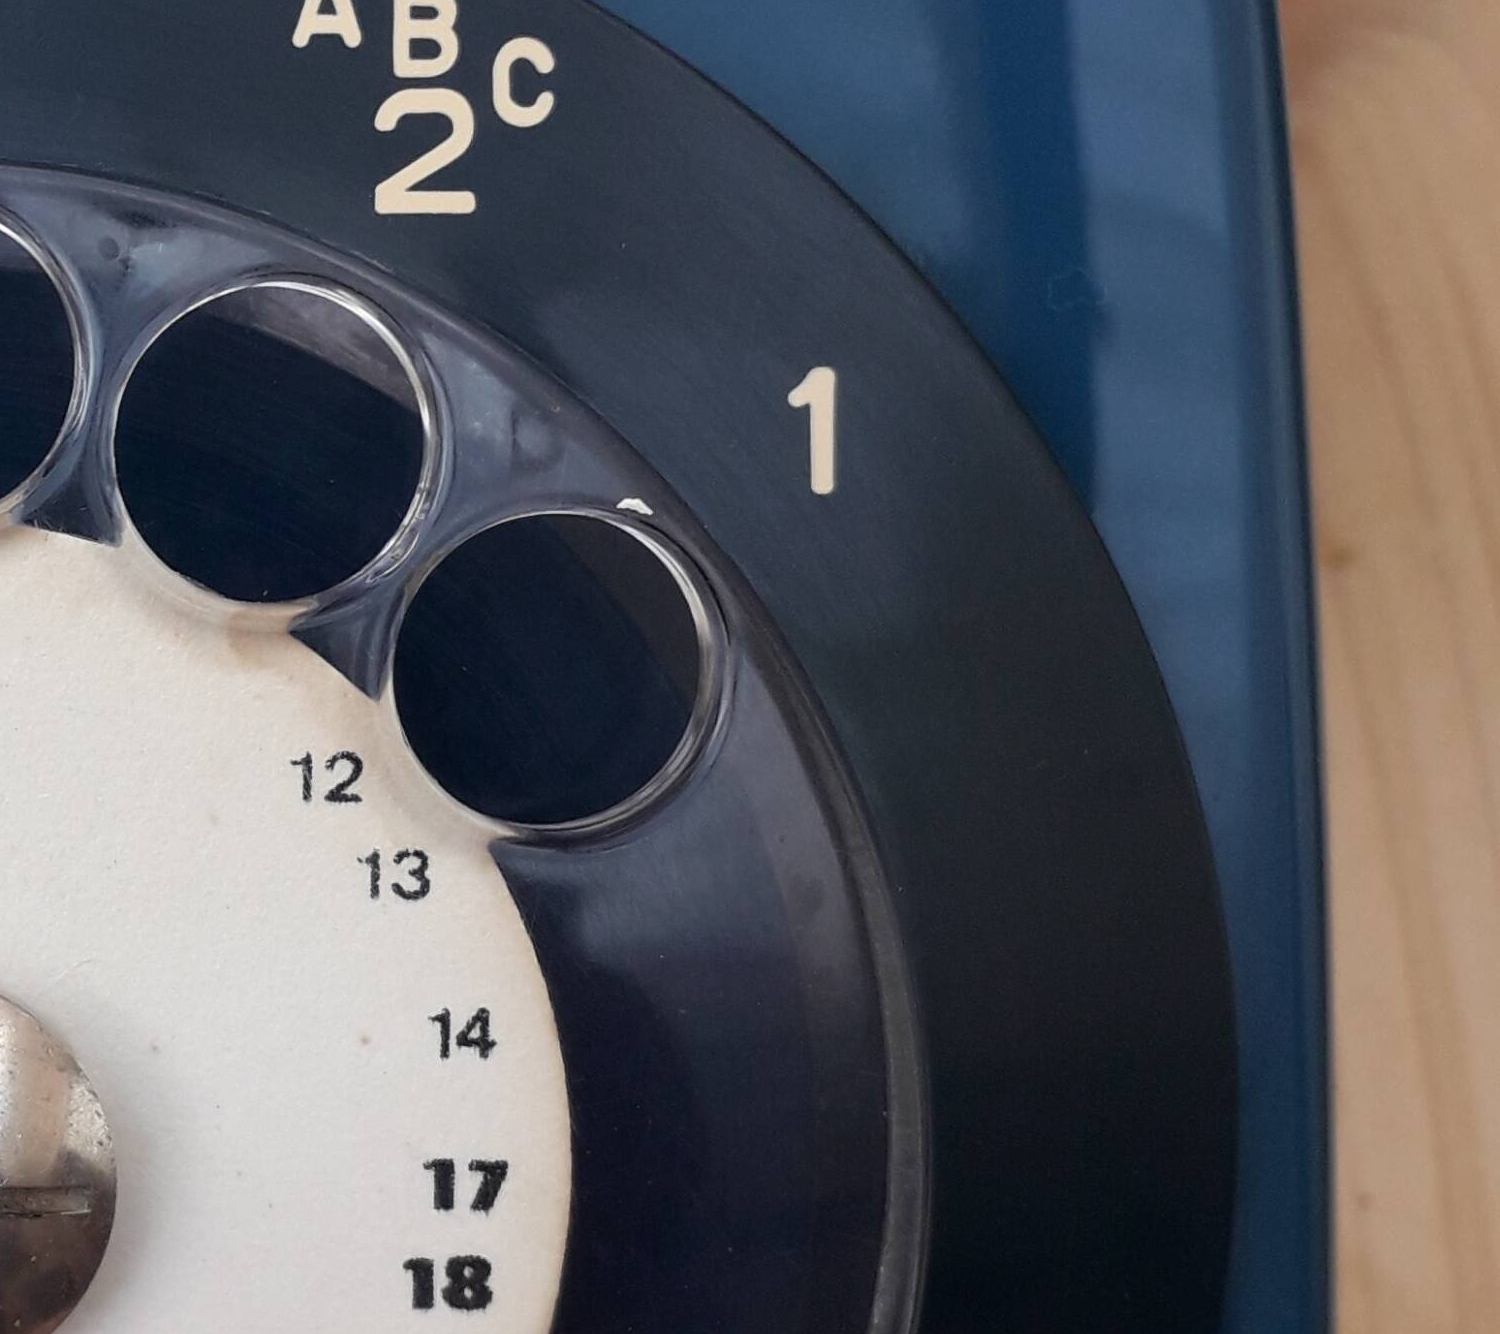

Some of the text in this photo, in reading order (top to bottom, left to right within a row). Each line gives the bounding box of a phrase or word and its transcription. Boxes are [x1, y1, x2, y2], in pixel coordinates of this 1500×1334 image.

[373, 86, 478, 216] 2
[786, 365, 838, 496] 1
[290, 749, 365, 805] 12
[356, 847, 432, 902] 13
[429, 1006, 498, 1060] 14
[422, 1156, 510, 1215] 17
[401, 1253, 495, 1313] 18
